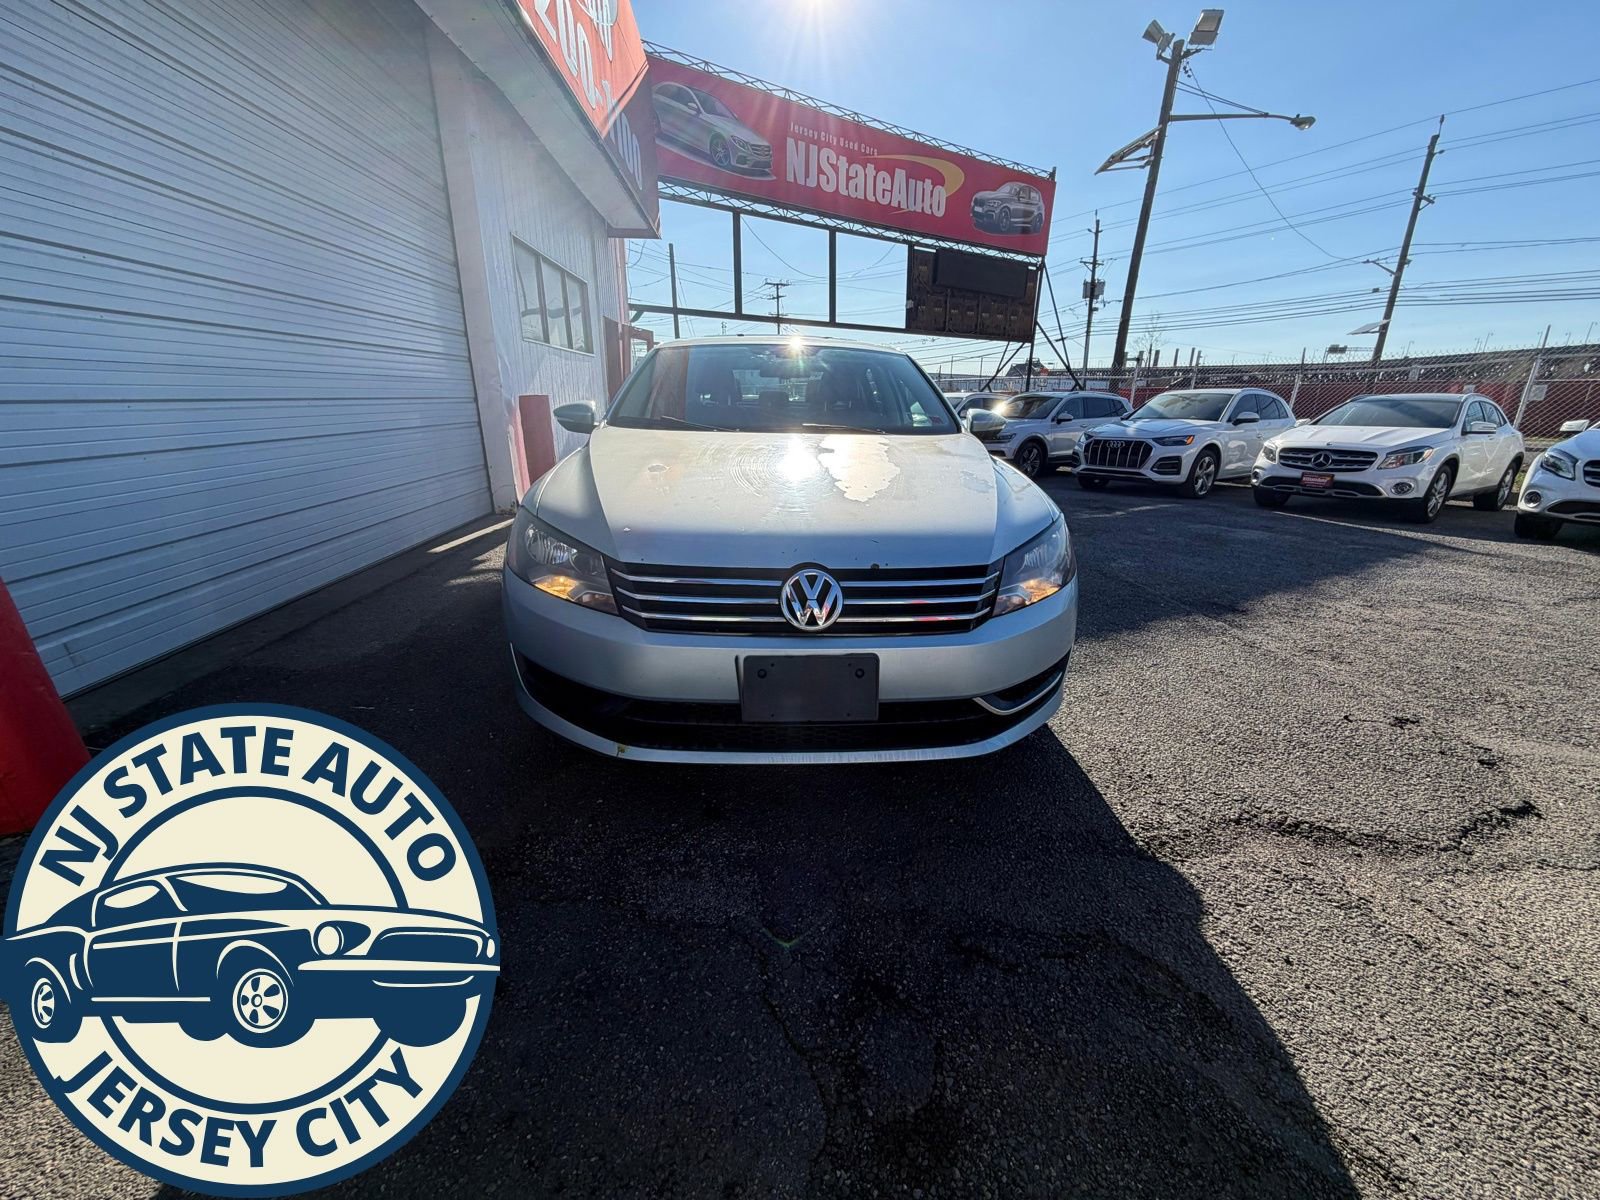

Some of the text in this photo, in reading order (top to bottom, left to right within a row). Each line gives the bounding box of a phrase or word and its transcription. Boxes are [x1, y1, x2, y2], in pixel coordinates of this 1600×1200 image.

[790, 122, 878, 156] Jersey City Used Cars
[786, 138, 947, 217] NJStateAuto
